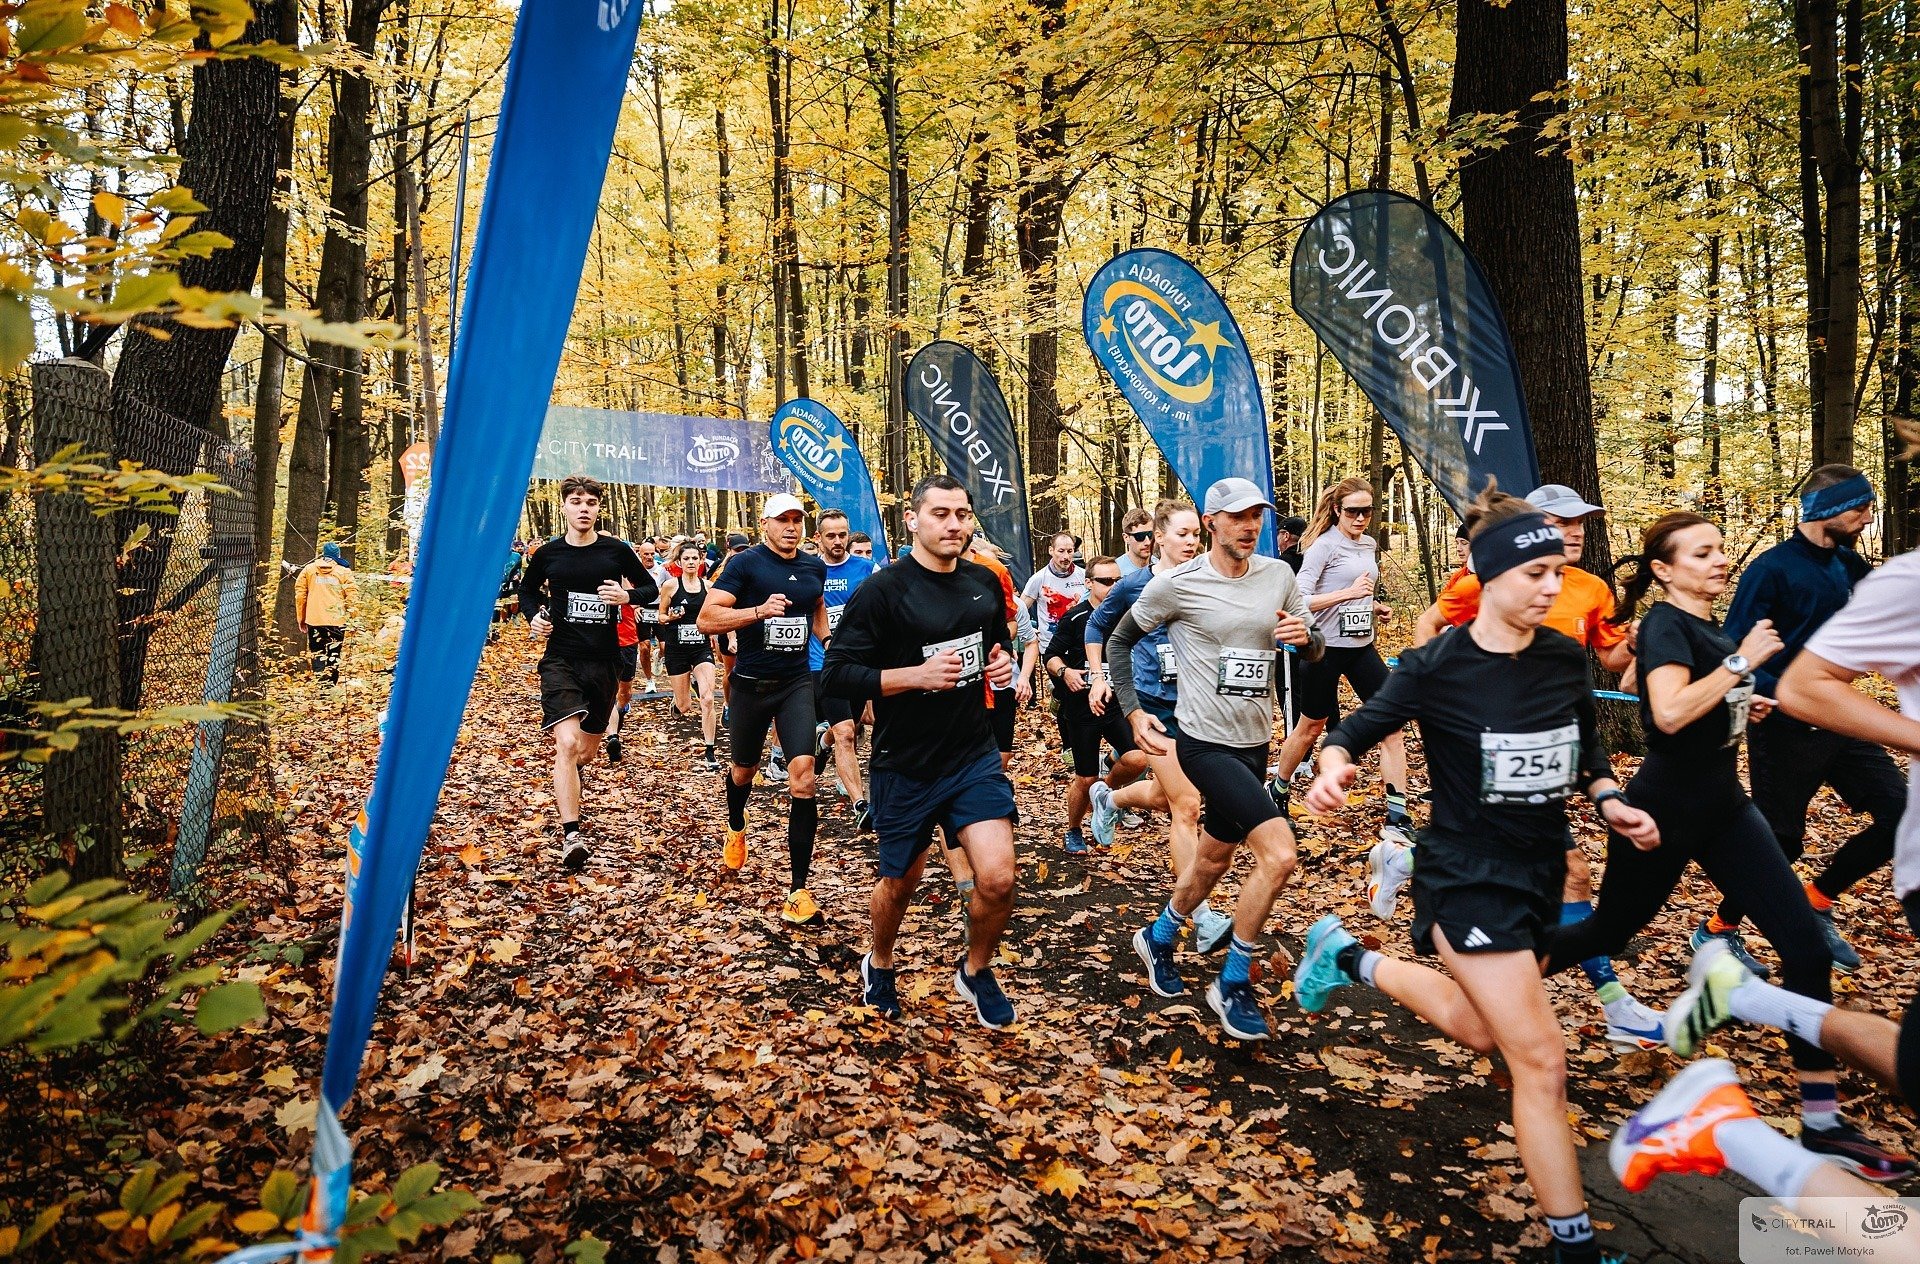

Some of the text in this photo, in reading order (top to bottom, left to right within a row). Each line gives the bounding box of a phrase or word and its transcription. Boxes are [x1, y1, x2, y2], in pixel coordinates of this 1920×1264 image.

[697, 446, 730, 462] LOTTO
[573, 601, 606, 614] 1040
[1346, 613, 1370, 625] 1047
[774, 627, 801, 639] 302
[1234, 662, 1264, 679] 236
[1509, 751, 1562, 778] 254
